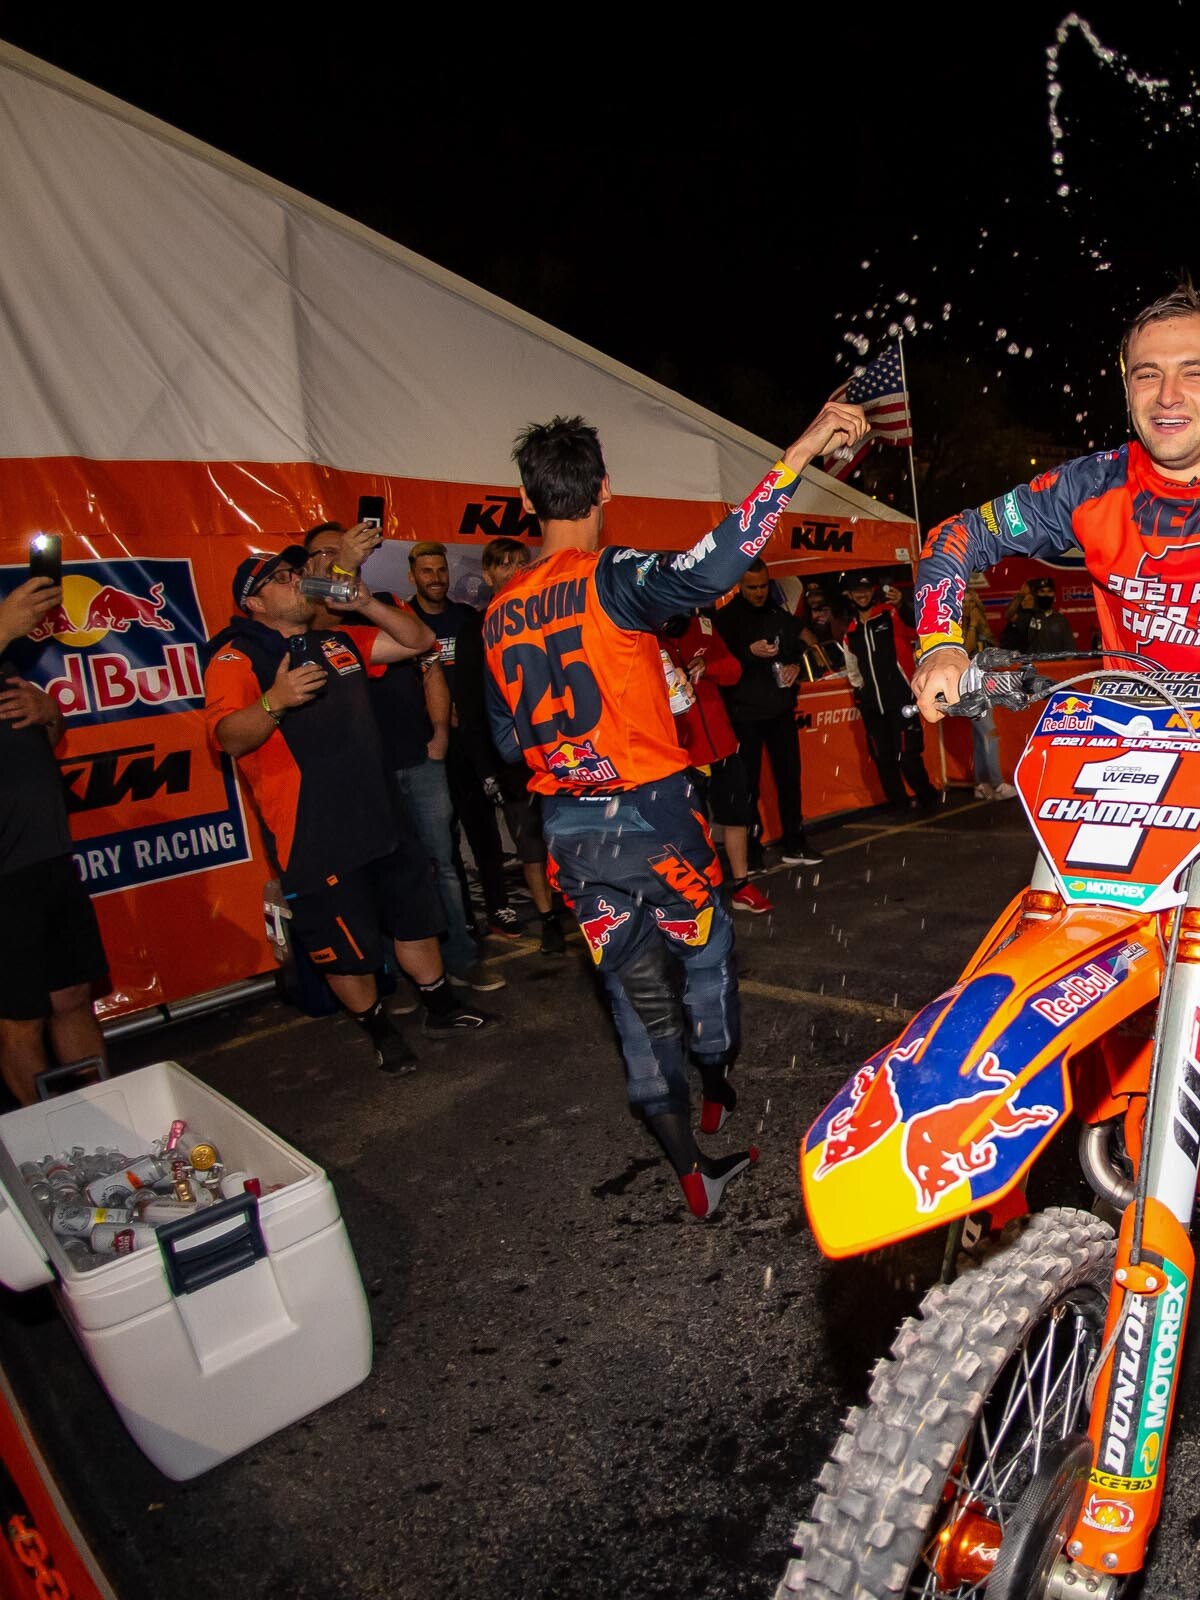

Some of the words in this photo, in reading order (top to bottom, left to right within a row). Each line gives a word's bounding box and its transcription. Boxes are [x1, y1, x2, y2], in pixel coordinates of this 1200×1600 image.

[764, 494, 791, 528] Bll
[791, 521, 853, 553] KTM
[1107, 573, 1184, 603] 2021
[88, 642, 205, 711] Bull
[501, 625, 603, 750] 25
[816, 707, 862, 727] FACTO
[1051, 736, 1085, 747] 2021
[1087, 737, 1117, 748] AMA
[1102, 772, 1160, 785] WEBB
[1105, 765, 1142, 773] COOPER
[132, 821, 237, 869] RACING
[1086, 881, 1147, 899] MOTOREX
[1144, 1279, 1187, 1428] MOTOREX
[1104, 1294, 1148, 1476] DUNLOP
